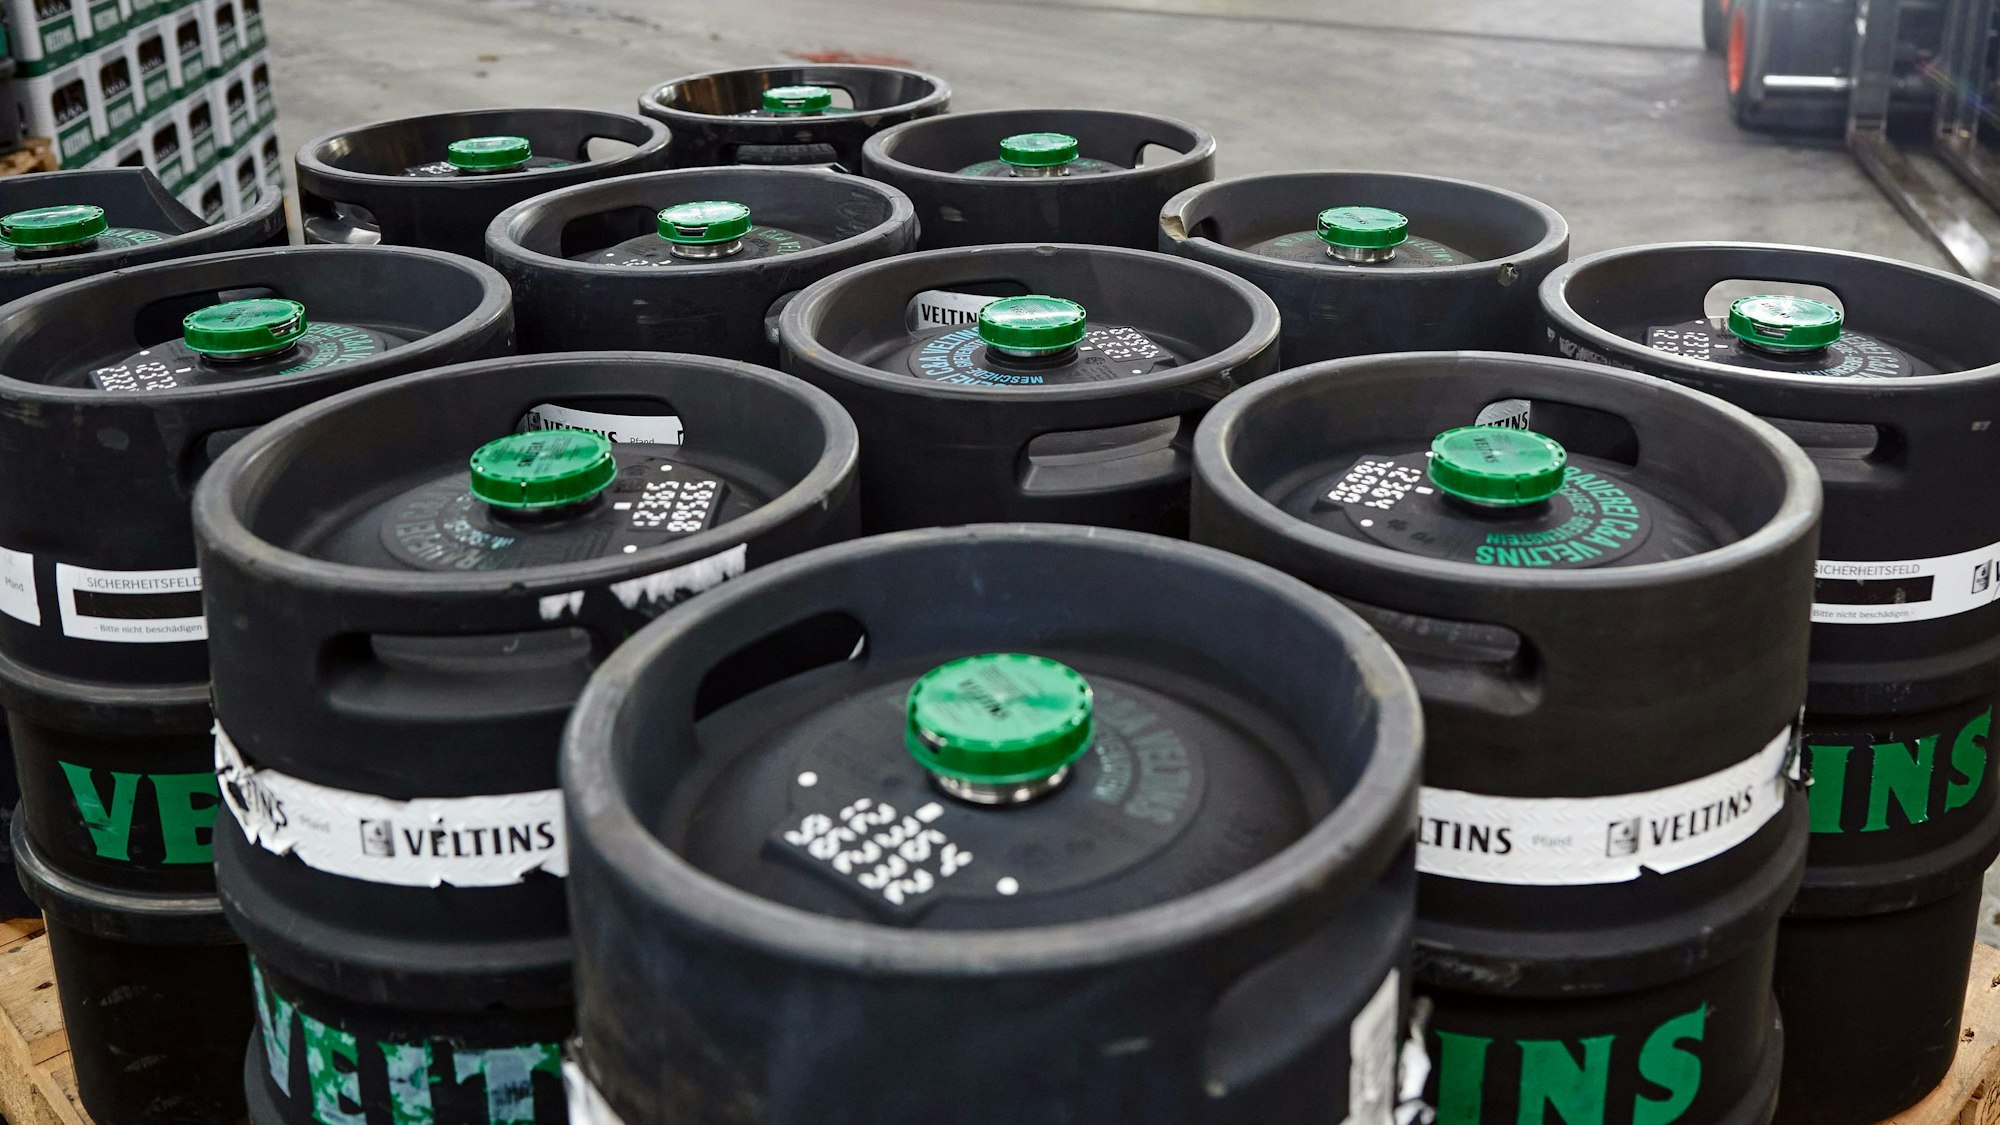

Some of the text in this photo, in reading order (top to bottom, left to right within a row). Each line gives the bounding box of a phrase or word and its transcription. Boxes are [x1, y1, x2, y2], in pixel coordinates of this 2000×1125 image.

[921, 303, 979, 326] VELTIN
[1580, 518, 1639, 549] C&A
[1475, 540, 1603, 567] VELTINS
[86, 576, 203, 590] SICHERHEITSFELD
[100, 624, 119, 633] Bitte
[121, 625, 143, 634] nicht
[1650, 785, 1753, 846] VELTINS
[403, 820, 555, 858] VELTINS
